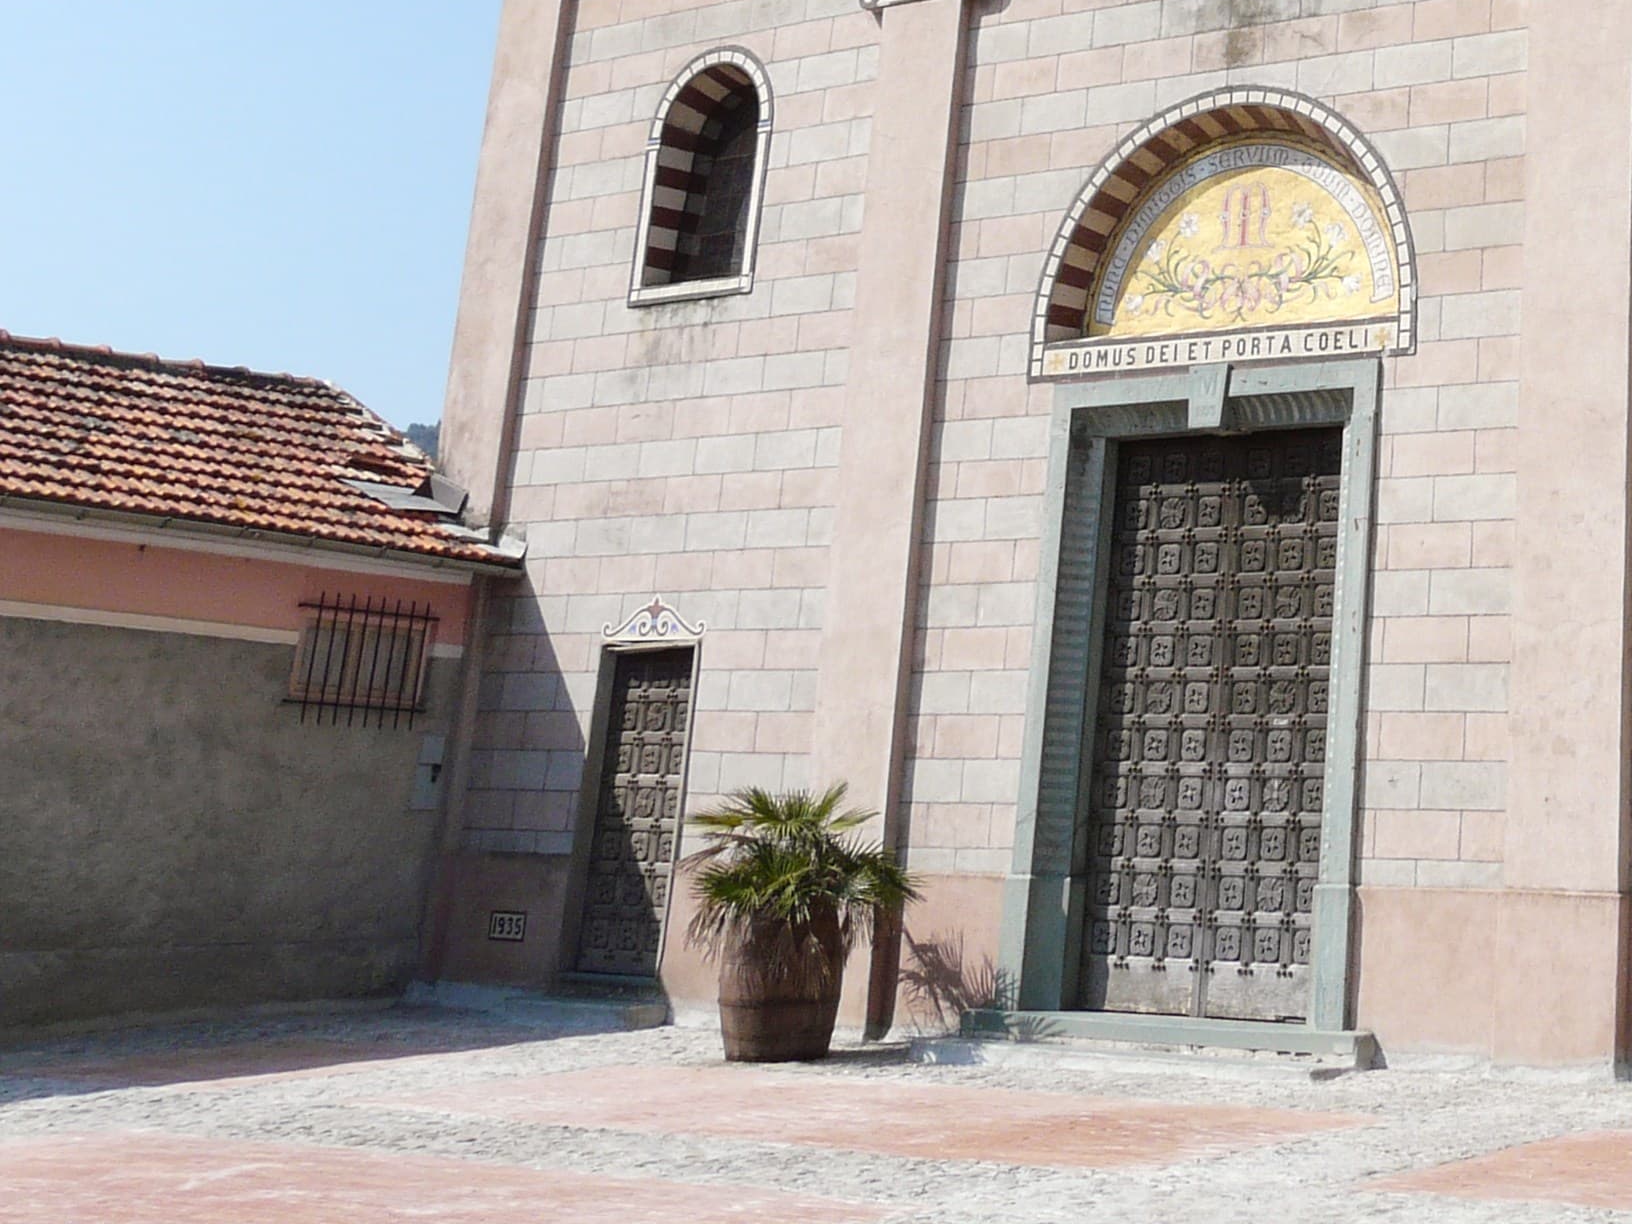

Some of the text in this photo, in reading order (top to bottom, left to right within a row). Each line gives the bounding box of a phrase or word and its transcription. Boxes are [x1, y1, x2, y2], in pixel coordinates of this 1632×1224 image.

[1068, 328, 1369, 370] DOMUS DEI ET PORTA COELI
[491, 916, 522, 935] 1935
